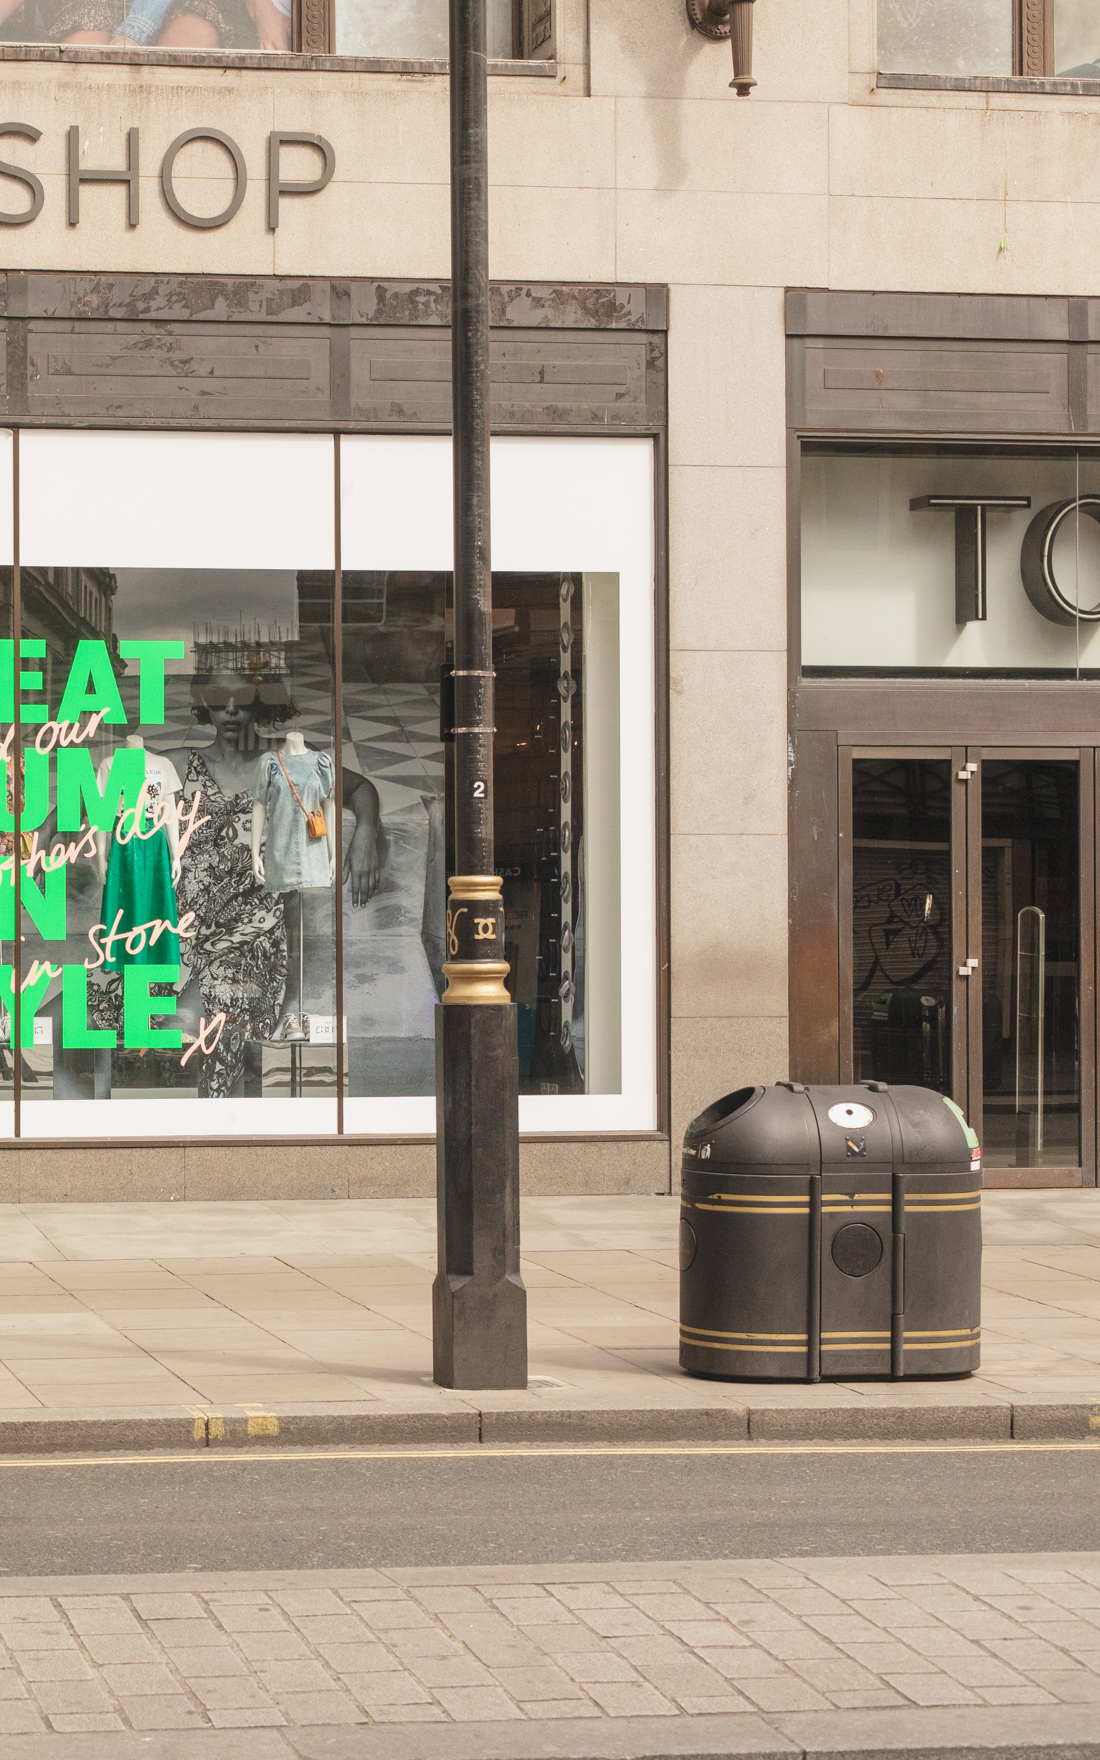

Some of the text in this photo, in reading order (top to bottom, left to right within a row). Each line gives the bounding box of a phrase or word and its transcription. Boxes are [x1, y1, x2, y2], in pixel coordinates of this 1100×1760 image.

[35, 707, 111, 755] our
[115, 781, 212, 858] day
[473, 781, 485, 798] 2
[10, 935, 63, 993] in
[84, 908, 197, 969] store
